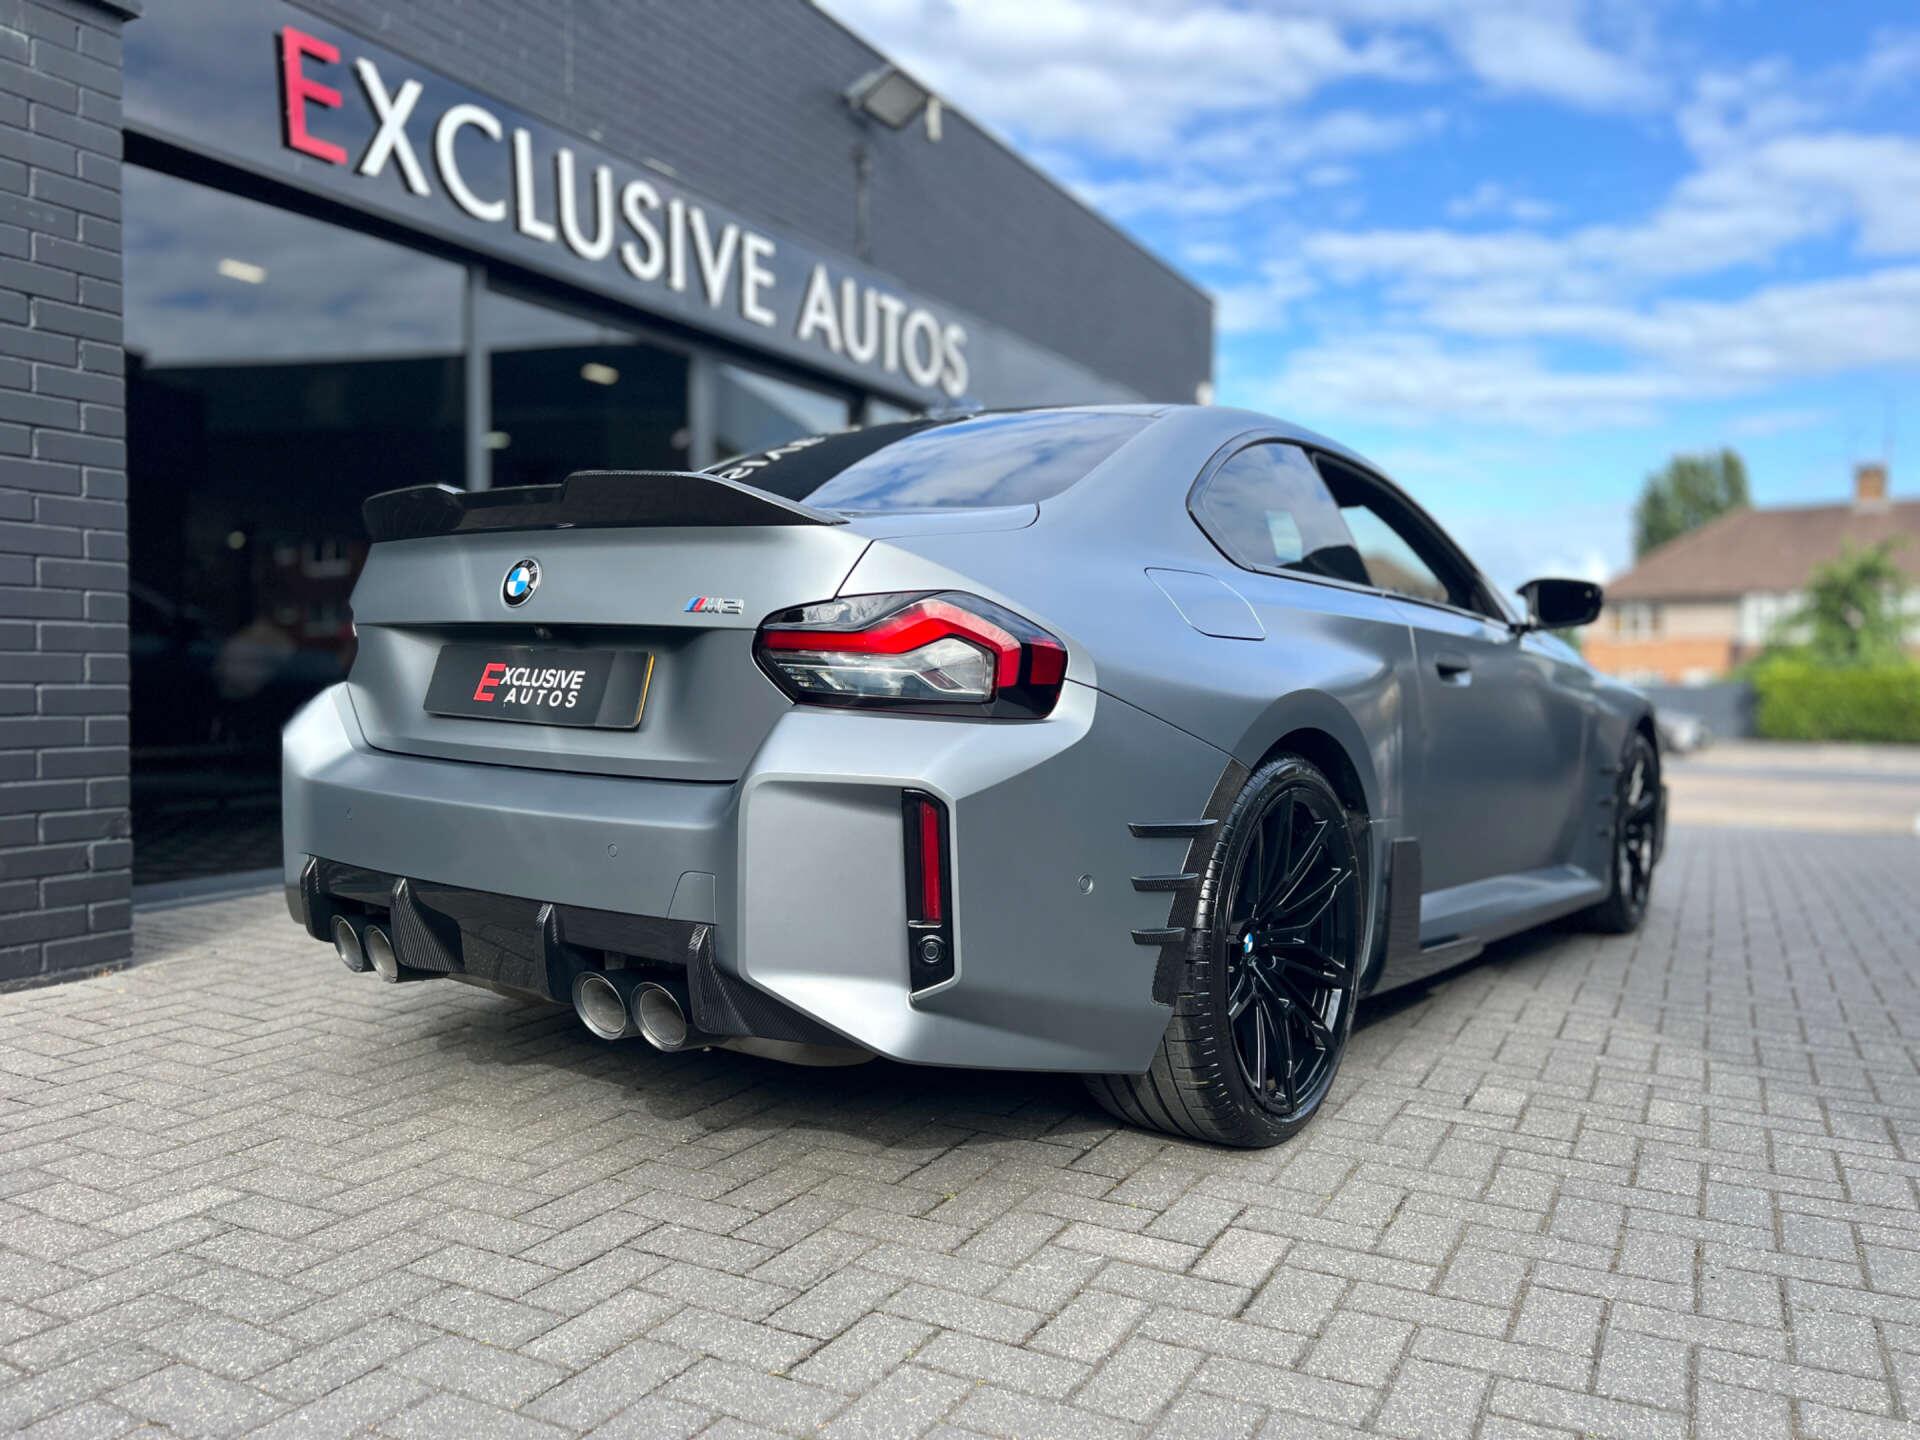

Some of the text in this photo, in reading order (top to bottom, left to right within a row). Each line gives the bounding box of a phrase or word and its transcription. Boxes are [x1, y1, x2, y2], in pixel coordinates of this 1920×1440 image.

[281, 26, 968, 398] EXCLUSIVE AUTOS
[473, 662, 586, 702] EXCLUSIVE
[503, 687, 579, 708] AUTOS
